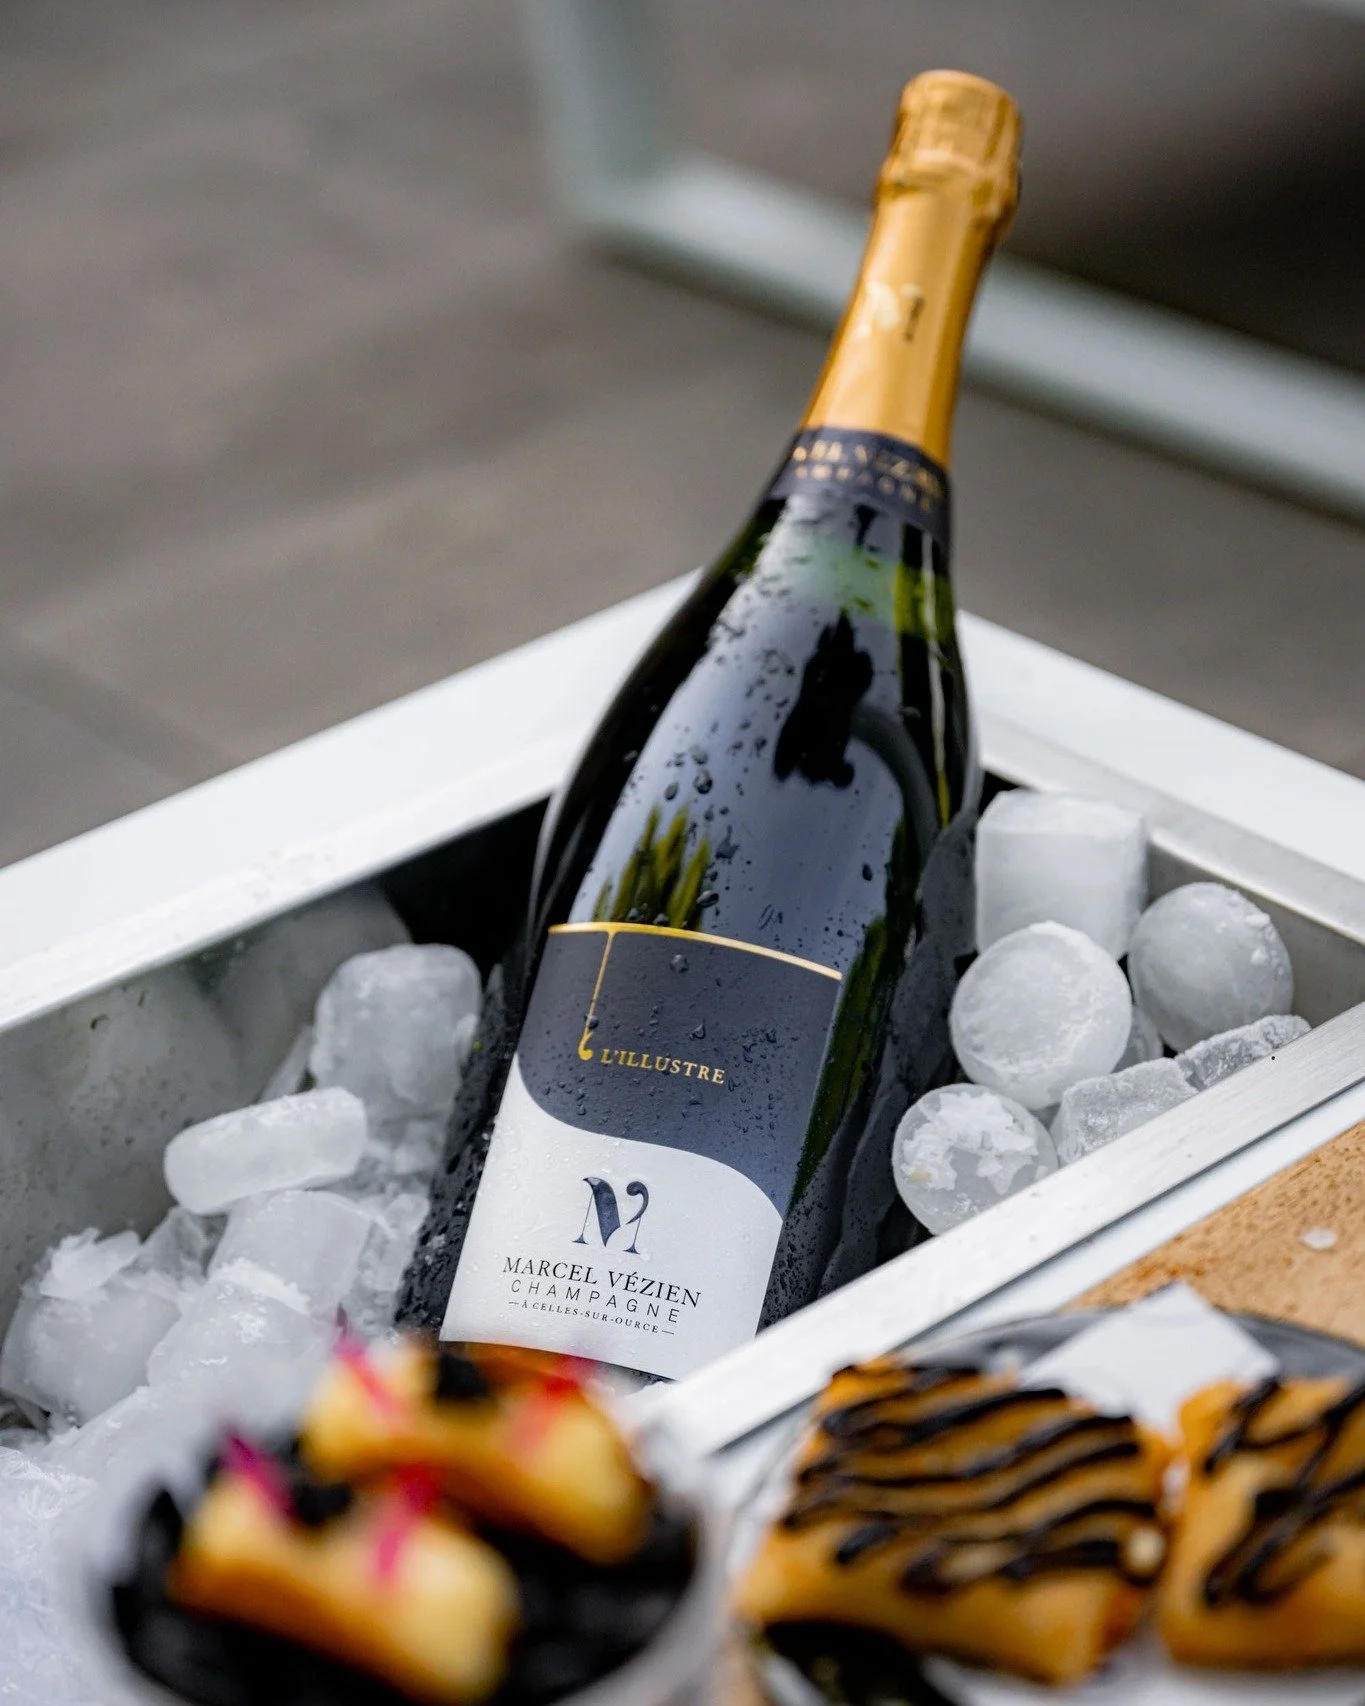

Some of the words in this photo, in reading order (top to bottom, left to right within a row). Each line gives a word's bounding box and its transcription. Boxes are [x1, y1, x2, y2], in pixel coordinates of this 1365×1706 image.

[600, 1048, 725, 1085] L'ILLUSTRE
[502, 1256, 598, 1285] MARCEL
[607, 1271, 702, 1308] VÉZIEN
[510, 1279, 680, 1323] CHAMPAGNE
